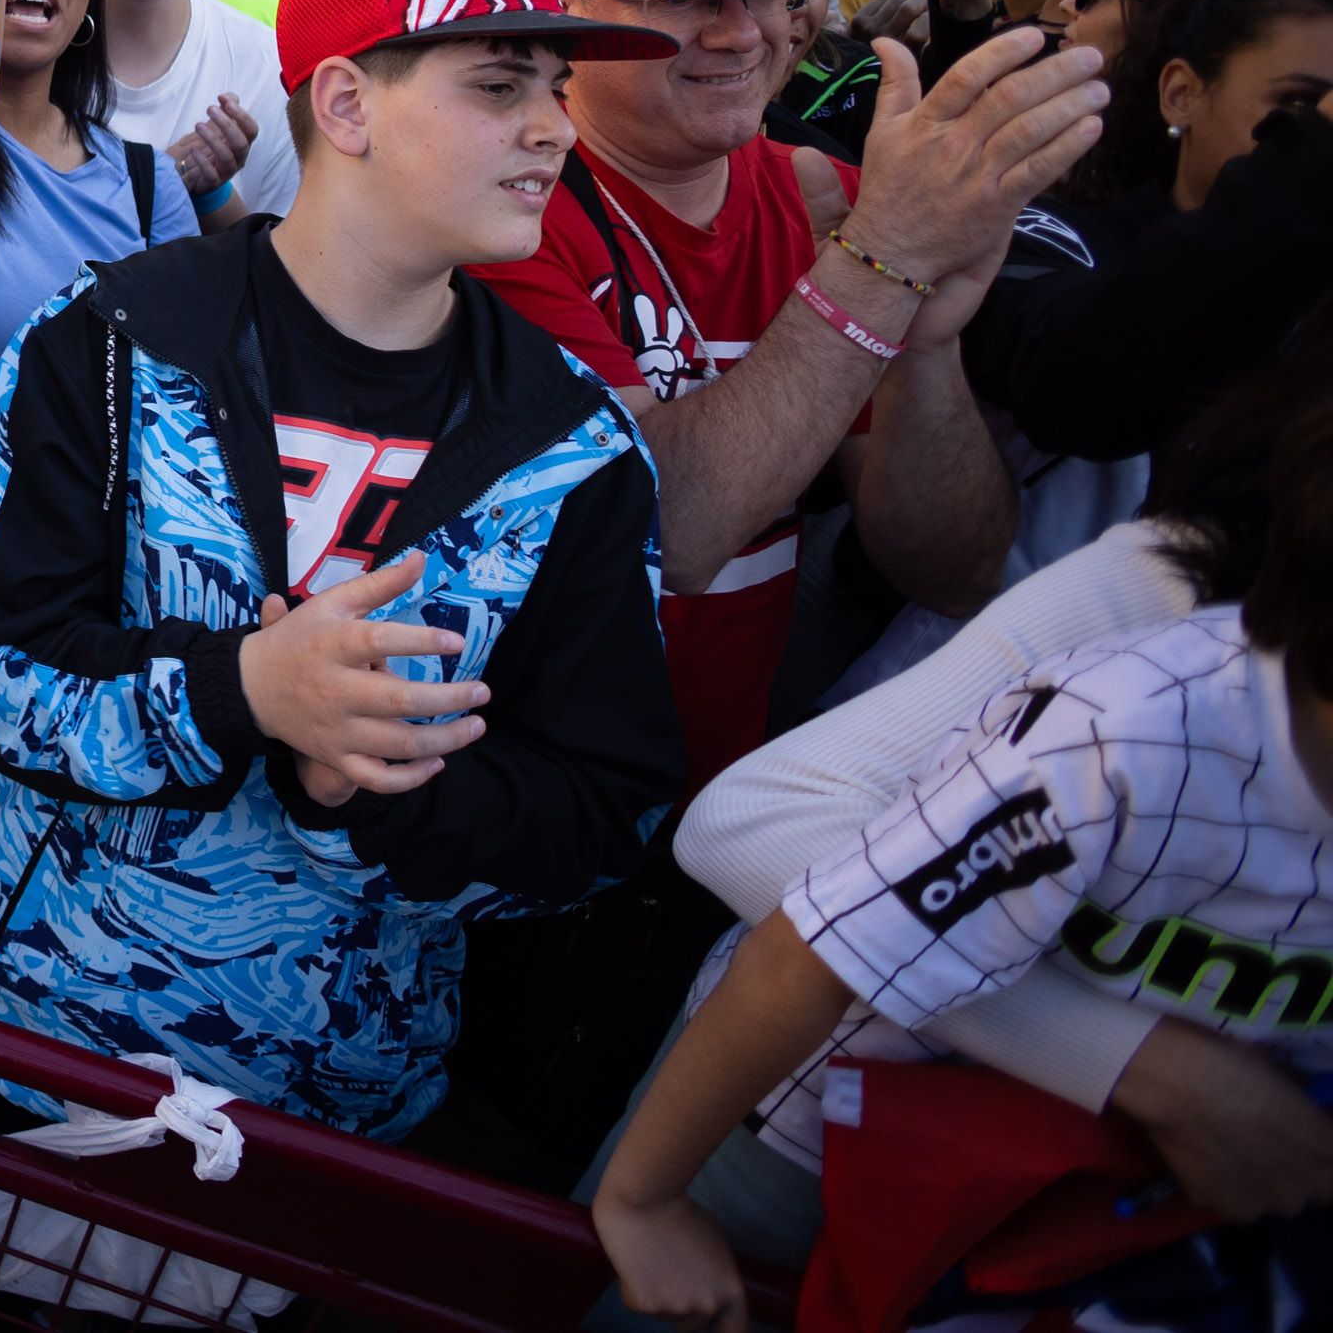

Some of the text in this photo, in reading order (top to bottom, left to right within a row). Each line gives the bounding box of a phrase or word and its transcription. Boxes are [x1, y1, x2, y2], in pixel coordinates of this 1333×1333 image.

[843, 321, 901, 359] MOTUL
[921, 805, 1065, 912] umbro
[1060, 900, 1333, 1030] um
